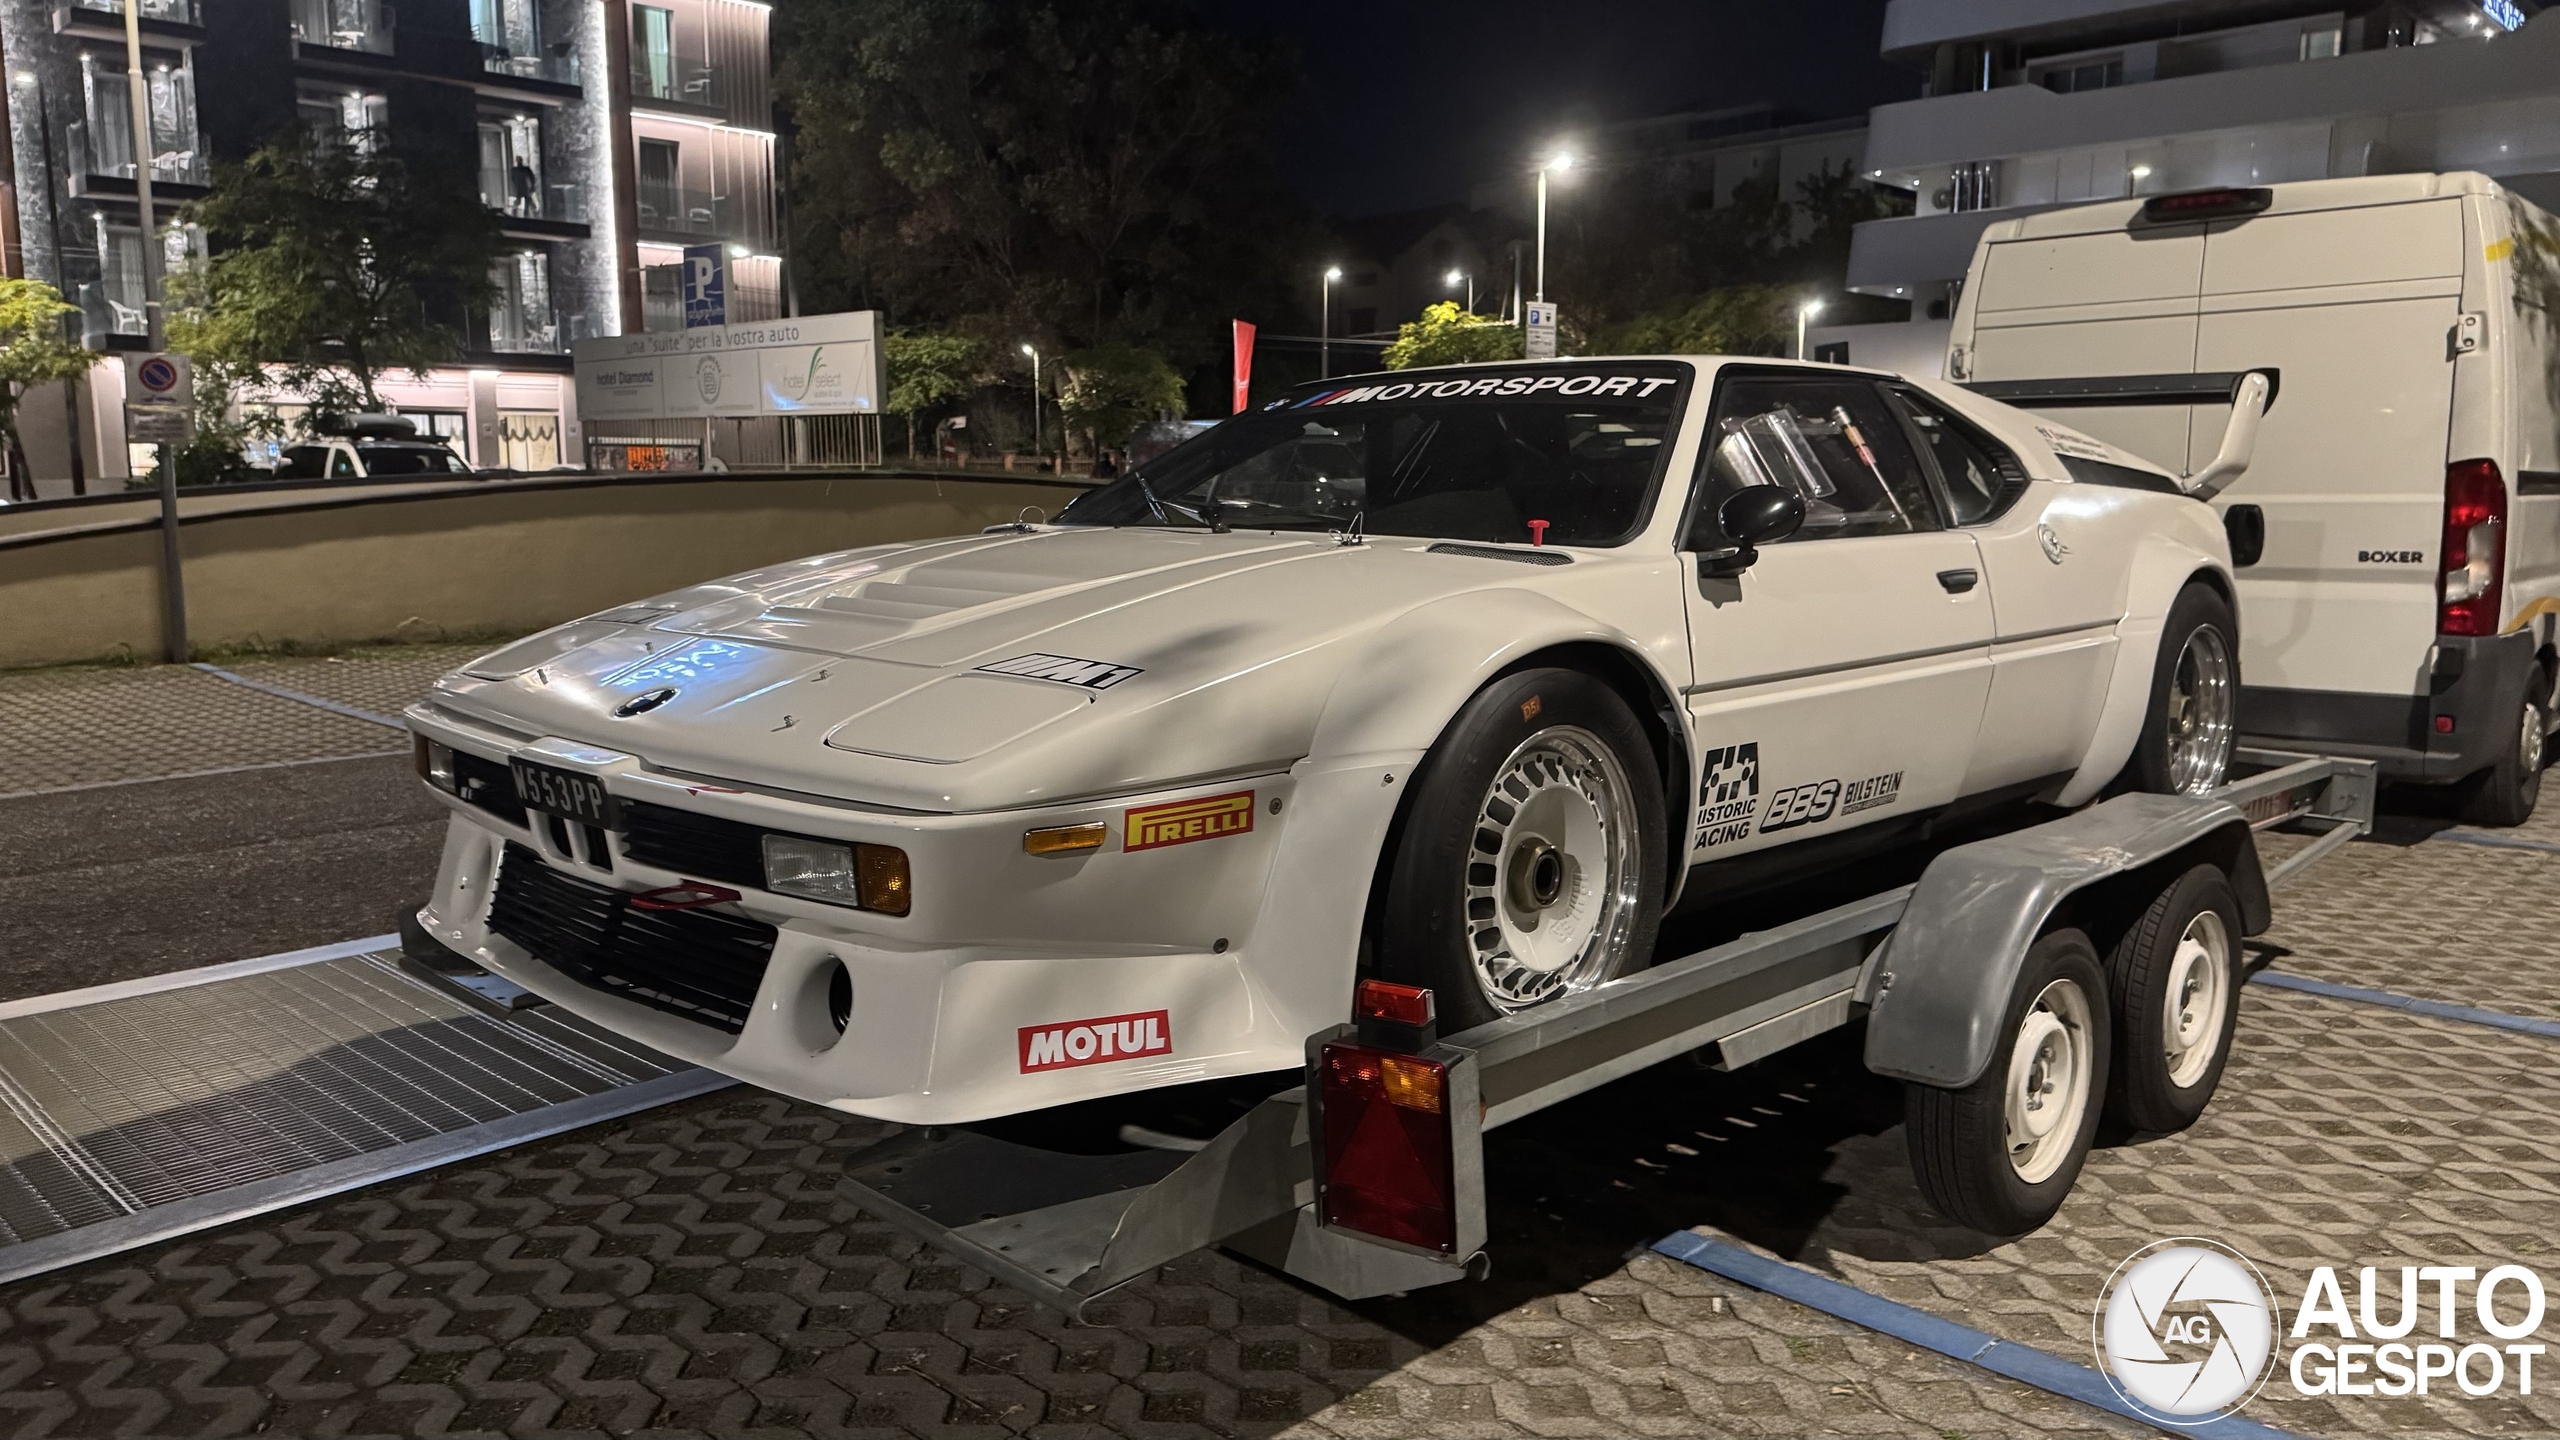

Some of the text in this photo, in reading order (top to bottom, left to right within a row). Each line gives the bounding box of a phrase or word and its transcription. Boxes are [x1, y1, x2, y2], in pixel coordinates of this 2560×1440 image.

[686, 256, 714, 299] P
[626, 341, 645, 355] una
[688, 335, 707, 352] per
[711, 331, 722, 347] la
[727, 330, 765, 346] vostra
[769, 327, 800, 343] auto
[619, 369, 654, 385] Diamond
[783, 369, 805, 389] hotel
[814, 371, 842, 389] select
[1327, 375, 1677, 405] MOTORSPORT
[2358, 550, 2424, 563] BOXER
[511, 762, 604, 820] W553PP
[1844, 771, 1903, 805] BILSTEIN
[1126, 795, 1251, 847] PIRELLI
[1760, 779, 1841, 833] BBS
[1693, 821, 1751, 851] ACING
[1026, 1017, 1166, 1067] MOTUL
